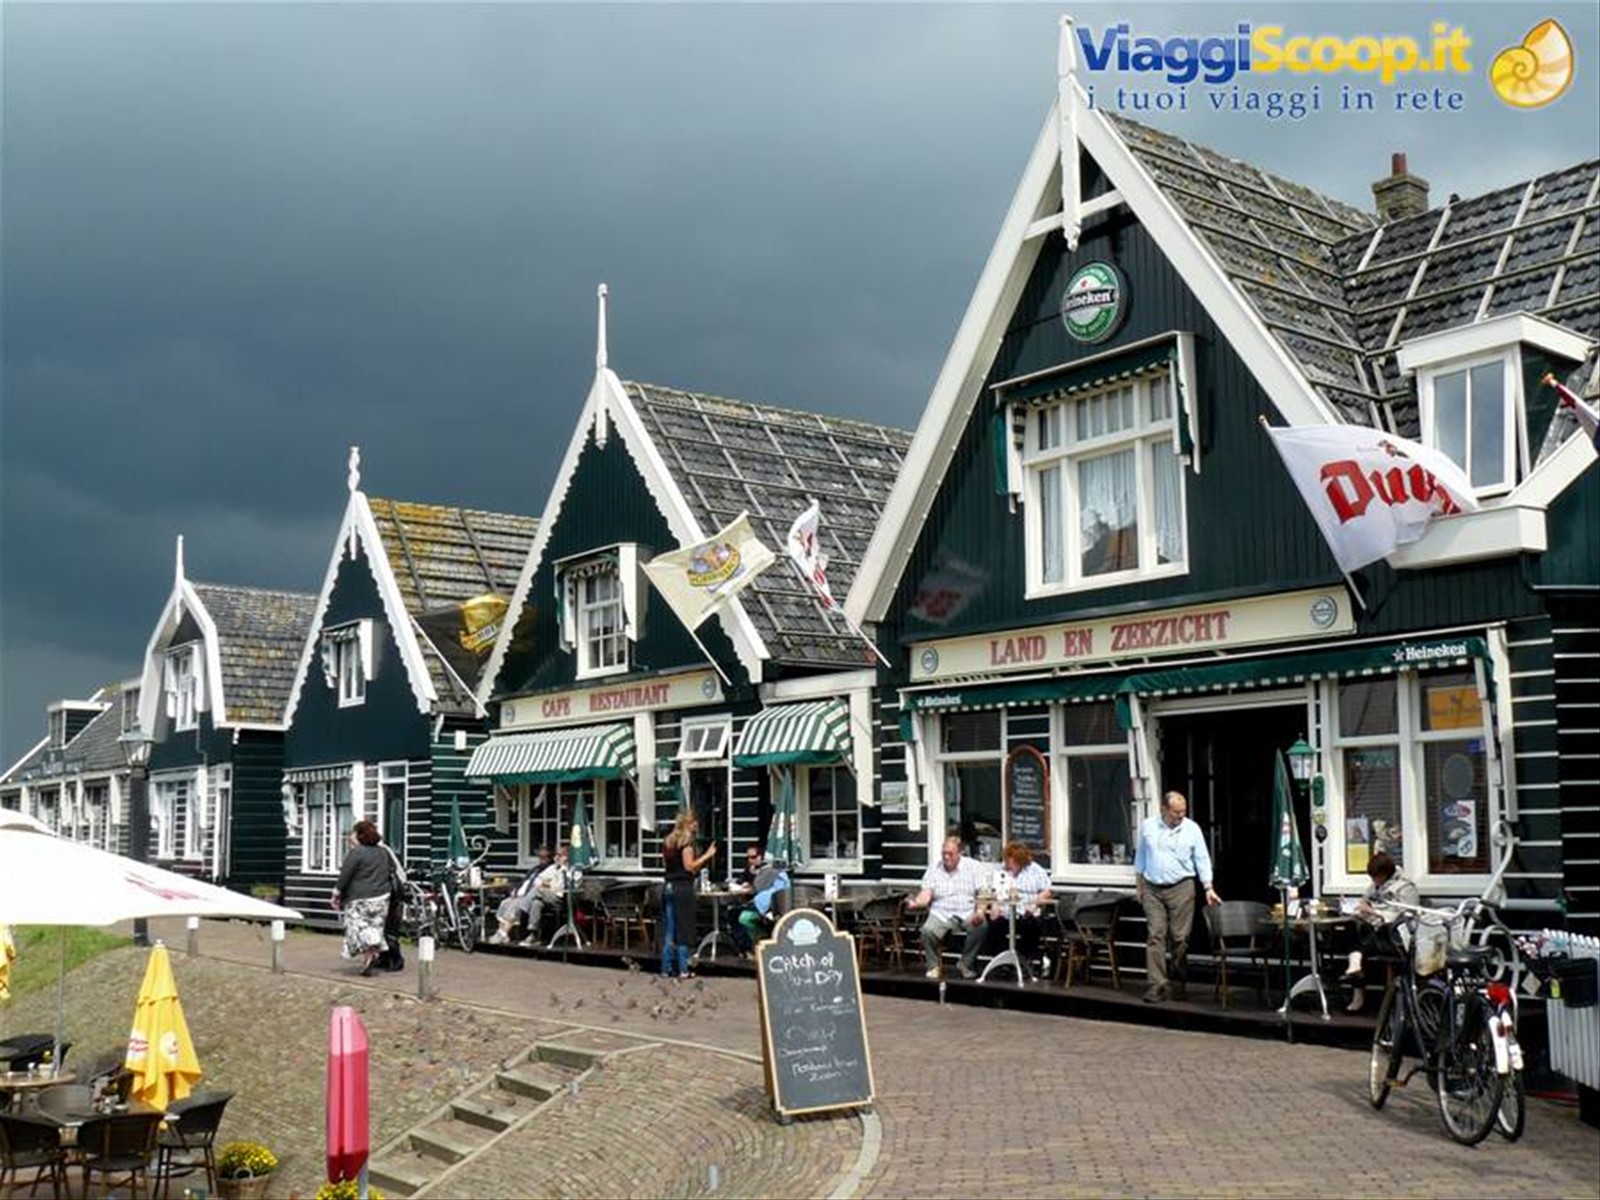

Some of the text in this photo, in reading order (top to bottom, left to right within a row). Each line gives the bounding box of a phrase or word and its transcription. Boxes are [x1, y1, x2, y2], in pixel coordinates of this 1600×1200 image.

[990, 611, 1230, 666] LAND EN ZEEZICHT
[1405, 642, 1467, 660] Heineken
[589, 684, 670, 712] RESTAURANT
